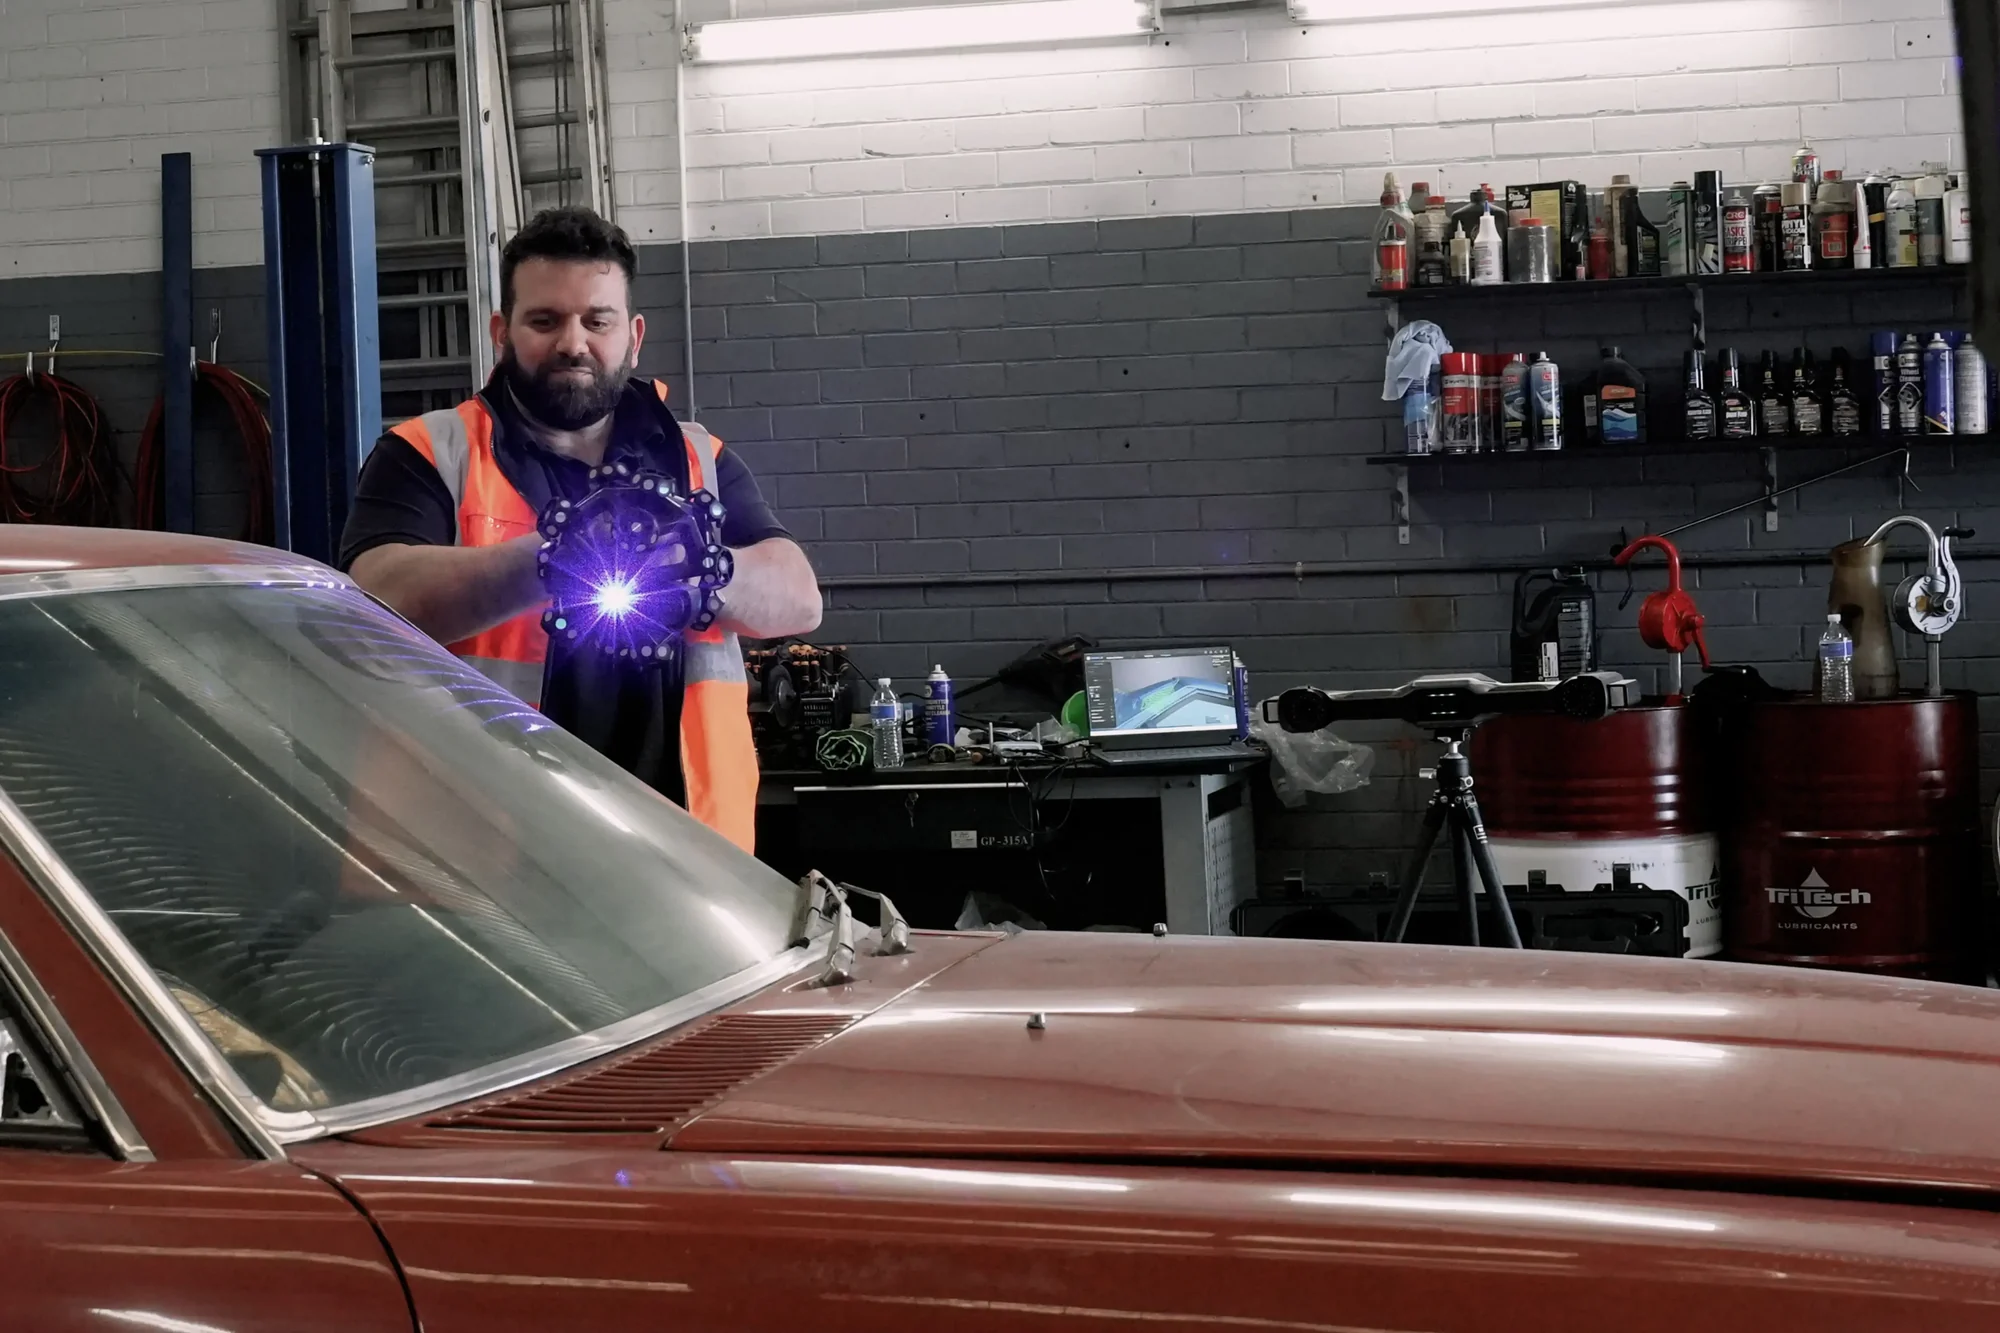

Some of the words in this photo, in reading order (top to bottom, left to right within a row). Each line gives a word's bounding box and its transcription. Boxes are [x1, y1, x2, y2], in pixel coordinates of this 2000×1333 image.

[1726, 211, 1746, 220] CRC
[1764, 887, 1871, 904] TriTech
[1777, 922, 1859, 931] LUBRICANTS
